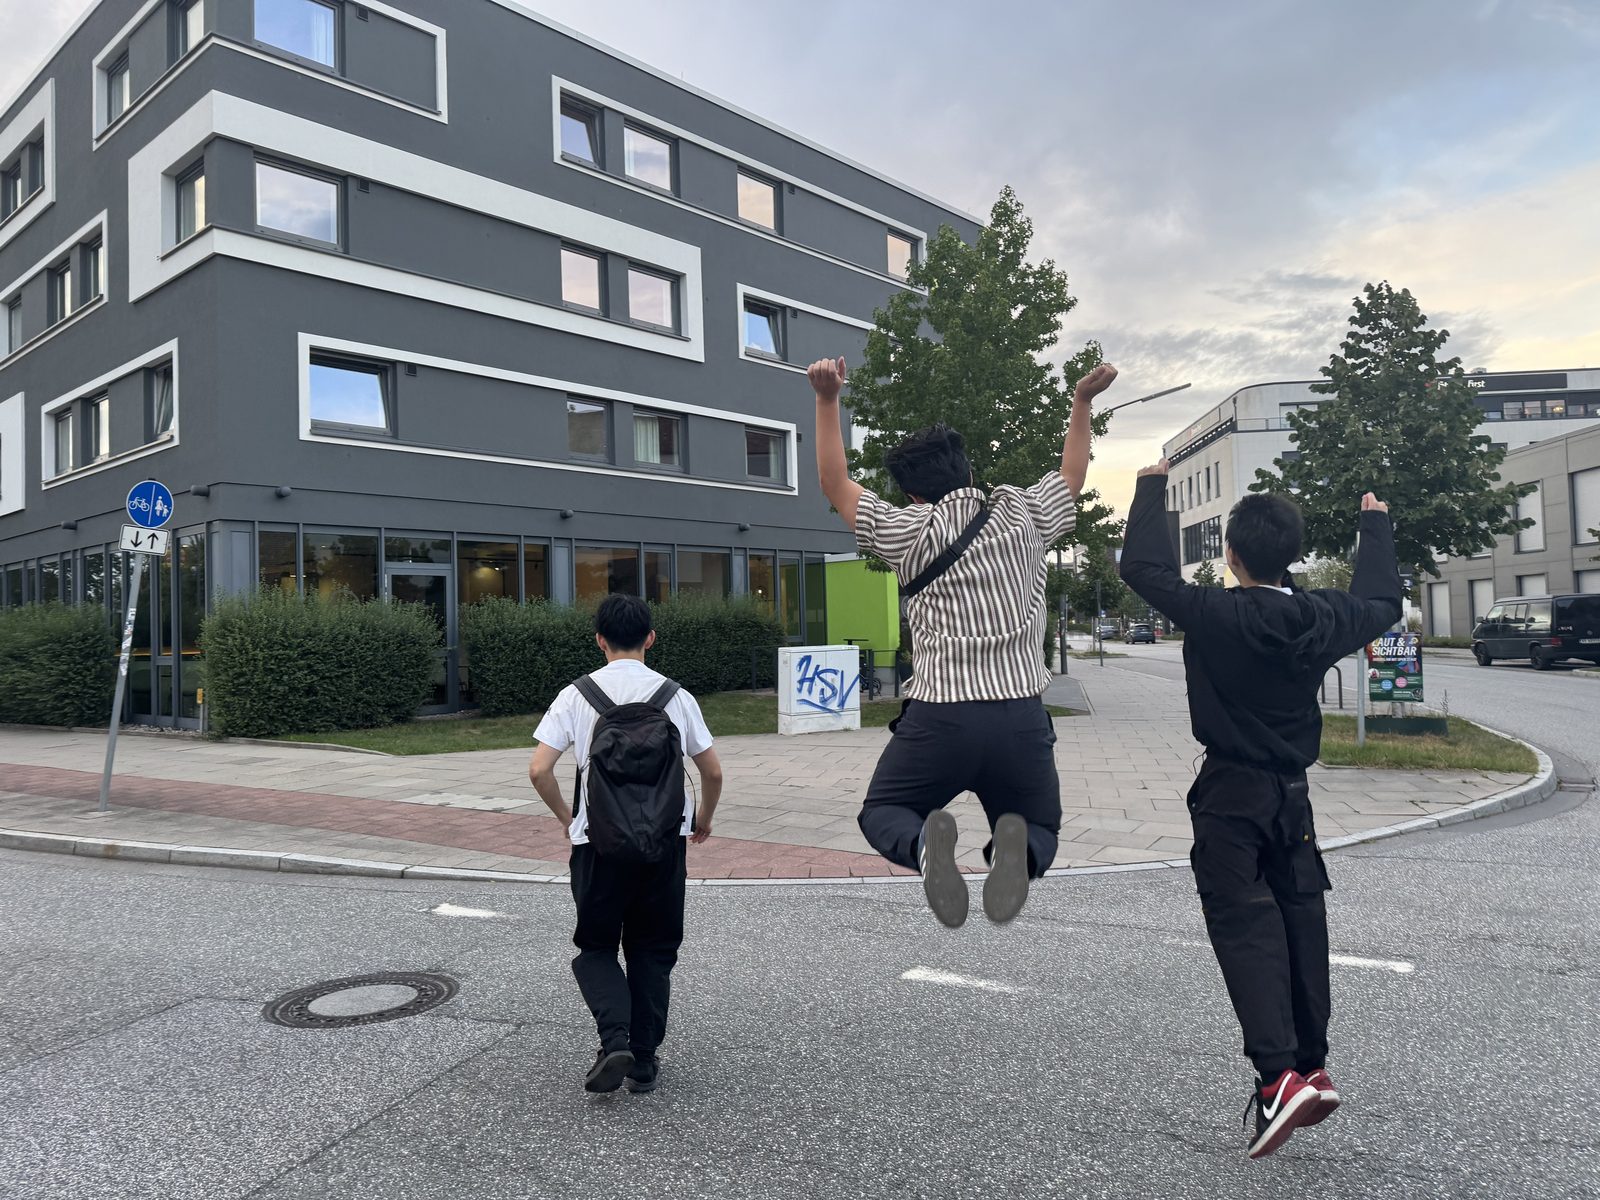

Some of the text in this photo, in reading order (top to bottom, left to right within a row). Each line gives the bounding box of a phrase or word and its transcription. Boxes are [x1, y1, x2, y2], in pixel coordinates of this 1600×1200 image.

[1372, 637, 1405, 646] LAUT &
[1372, 646, 1417, 656] SICHTBAR
[796, 654, 860, 711] HSV
